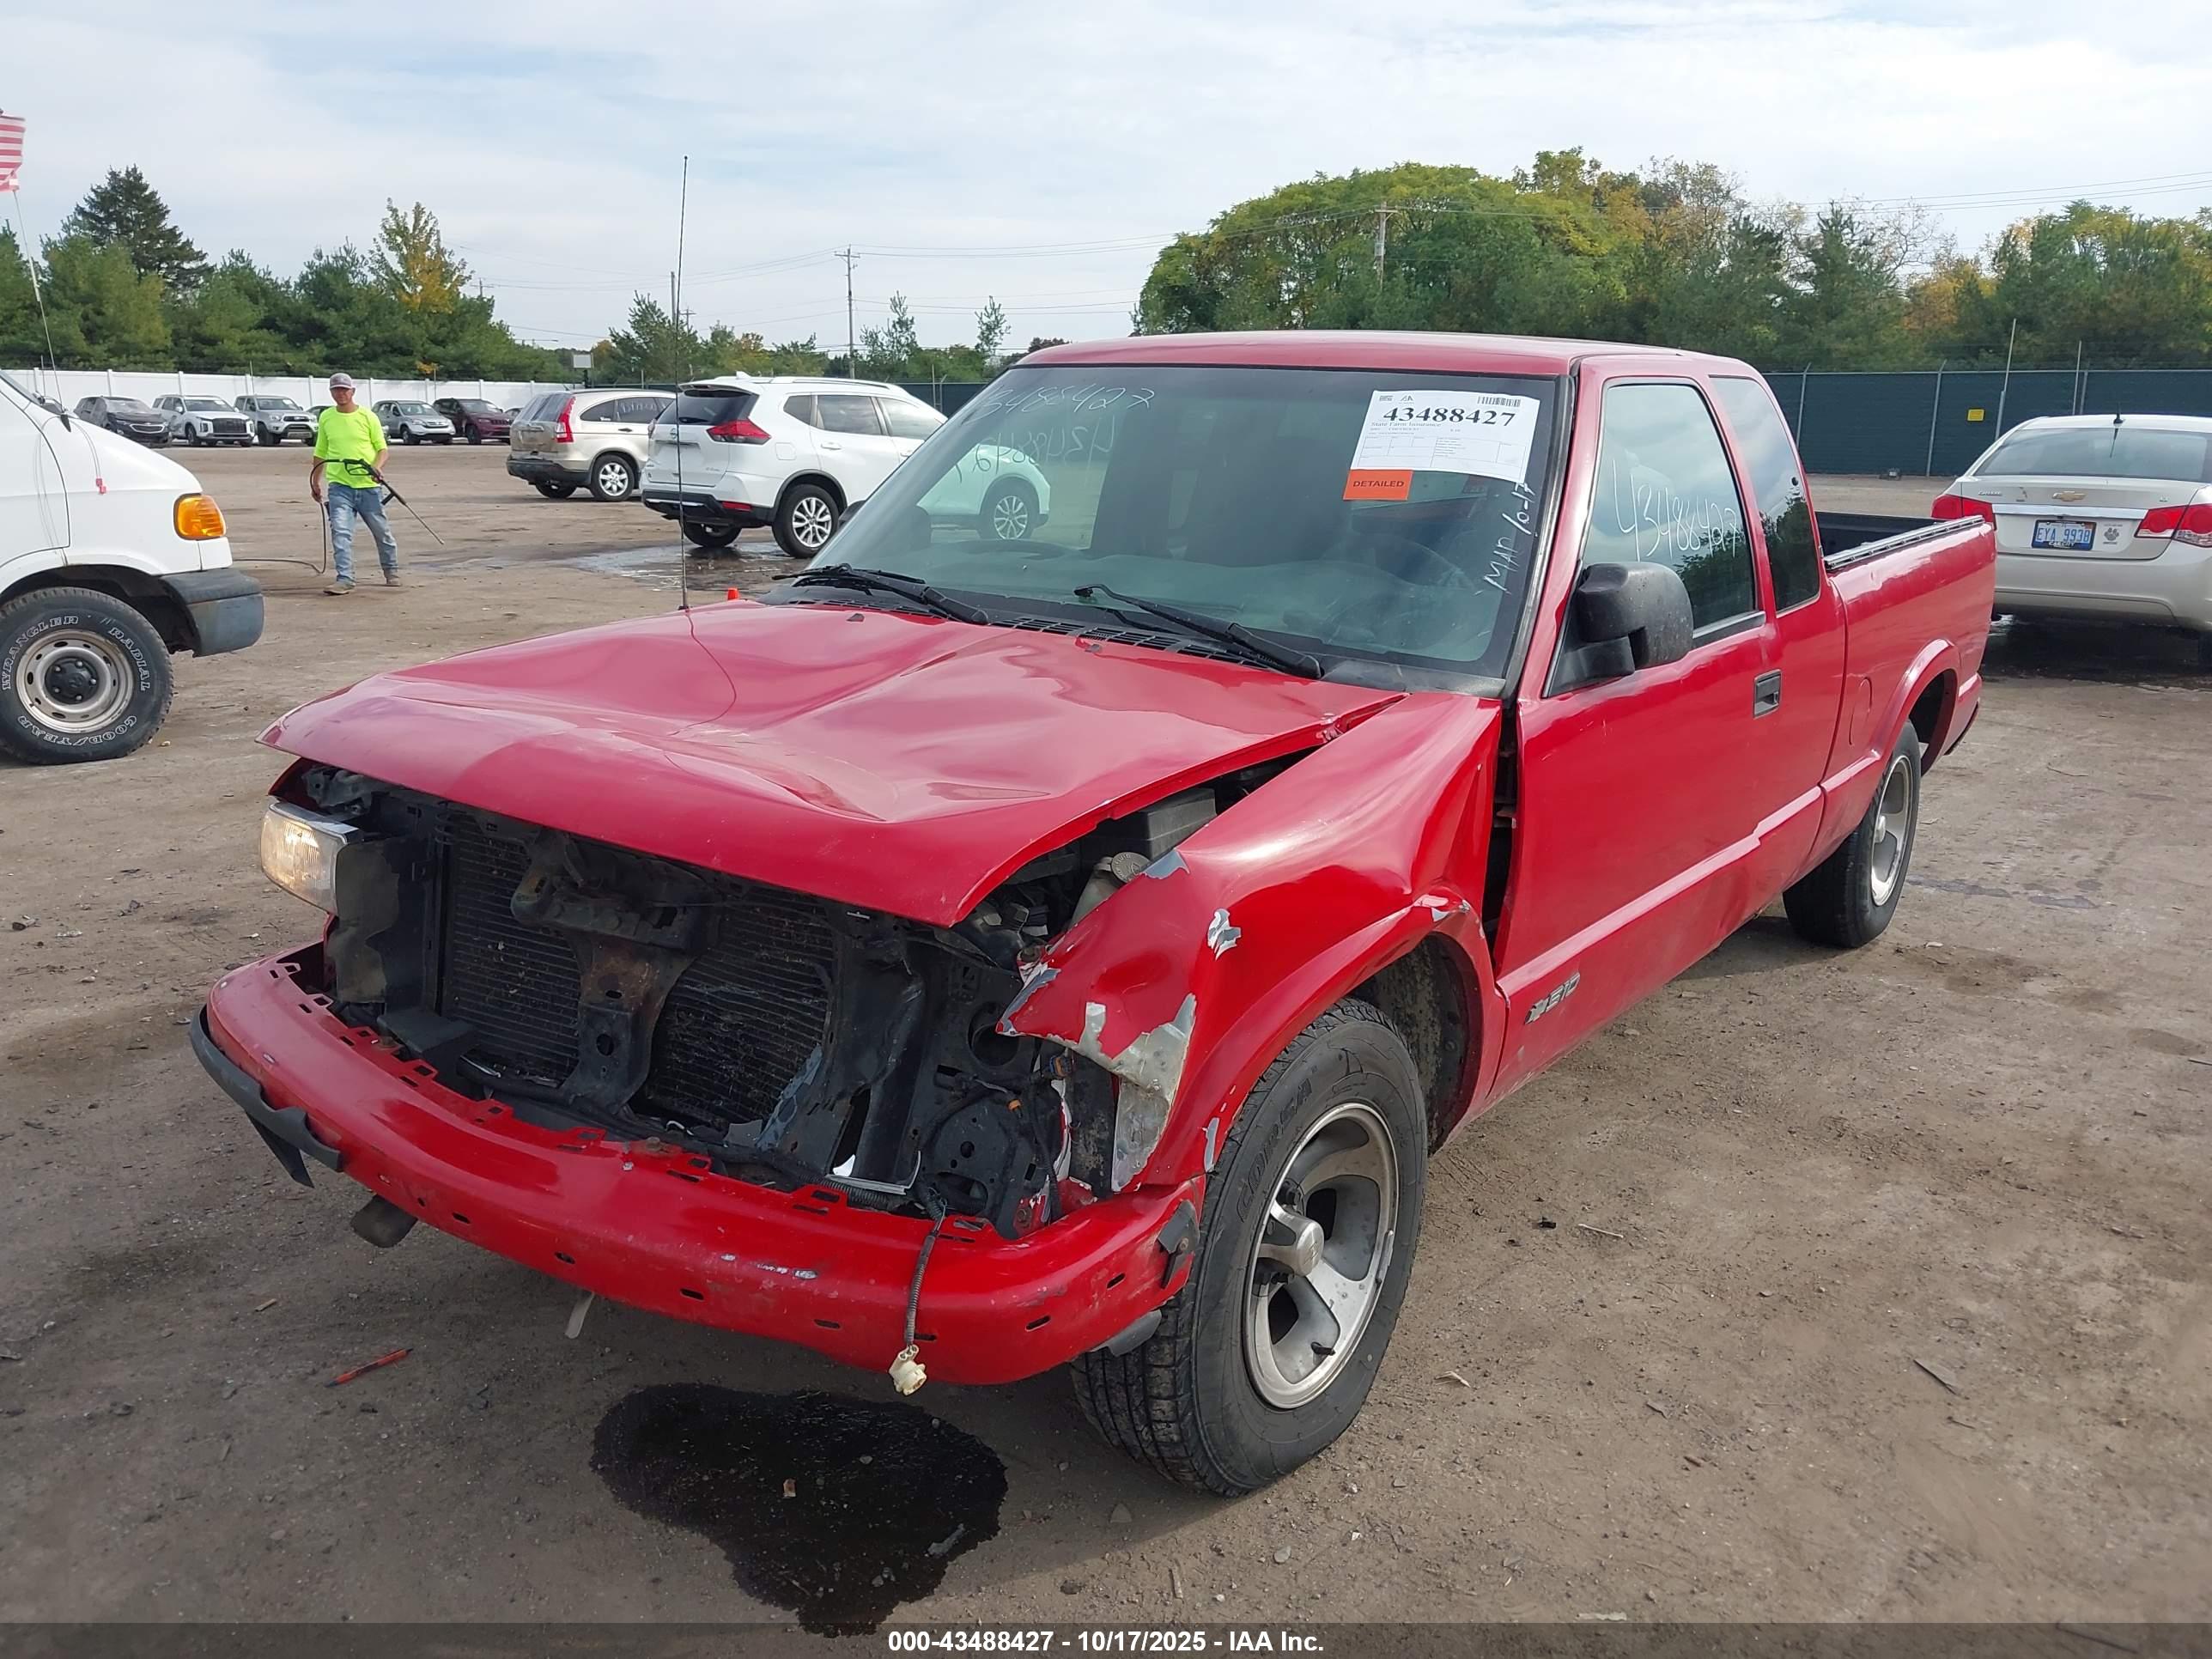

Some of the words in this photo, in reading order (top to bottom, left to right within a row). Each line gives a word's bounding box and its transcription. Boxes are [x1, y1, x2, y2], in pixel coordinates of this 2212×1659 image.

[1383, 406, 1516, 427] 43488427
[2037, 527, 2056, 540] EYA
[2, 616, 79, 690] WRANGLER
[108, 627, 152, 692] RADIAL
